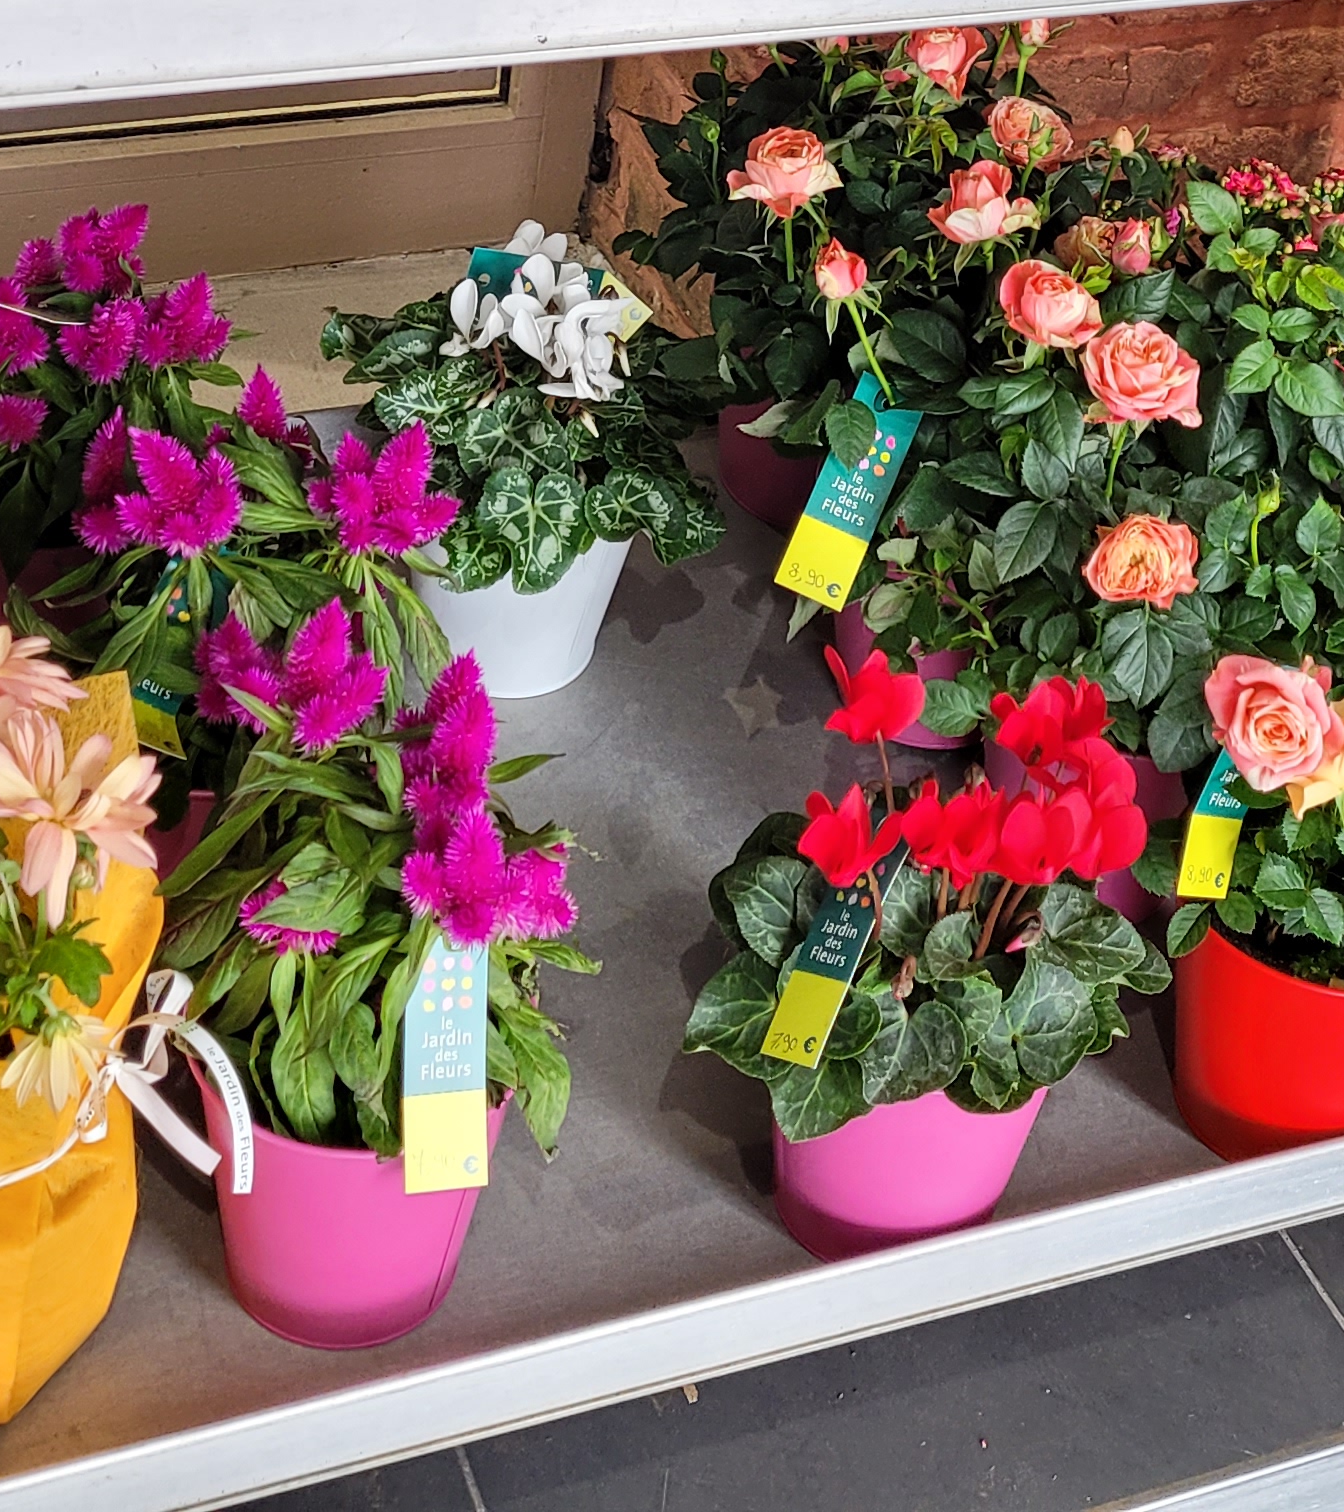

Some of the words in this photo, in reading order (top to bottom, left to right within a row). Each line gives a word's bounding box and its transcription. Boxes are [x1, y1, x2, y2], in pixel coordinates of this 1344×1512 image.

[852, 471, 864, 485] le
[831, 475, 875, 504] Jardin
[838, 493, 858, 510] des
[821, 498, 865, 527] Fleurs
[826, 583, 842, 599] €
[137, 677, 173, 700] eurs
[1219, 769, 1240, 783] Jar
[1214, 872, 1226, 889] €
[839, 908, 851, 922] le
[821, 918, 858, 940] Jardin
[824, 935, 842, 951] des
[809, 945, 847, 968] Fleurs
[441, 1016, 453, 1030] le
[421, 1029, 472, 1049] Jardin
[803, 1036, 817, 1054] €
[206, 1046, 216, 1057] le
[435, 1047, 458, 1063] des
[421, 1062, 472, 1081] Fleurs
[214, 1058, 241, 1107] Jardin
[235, 1110, 245, 1133] des
[239, 1136, 251, 1191] Fleurs
[463, 1155, 479, 1175] €
